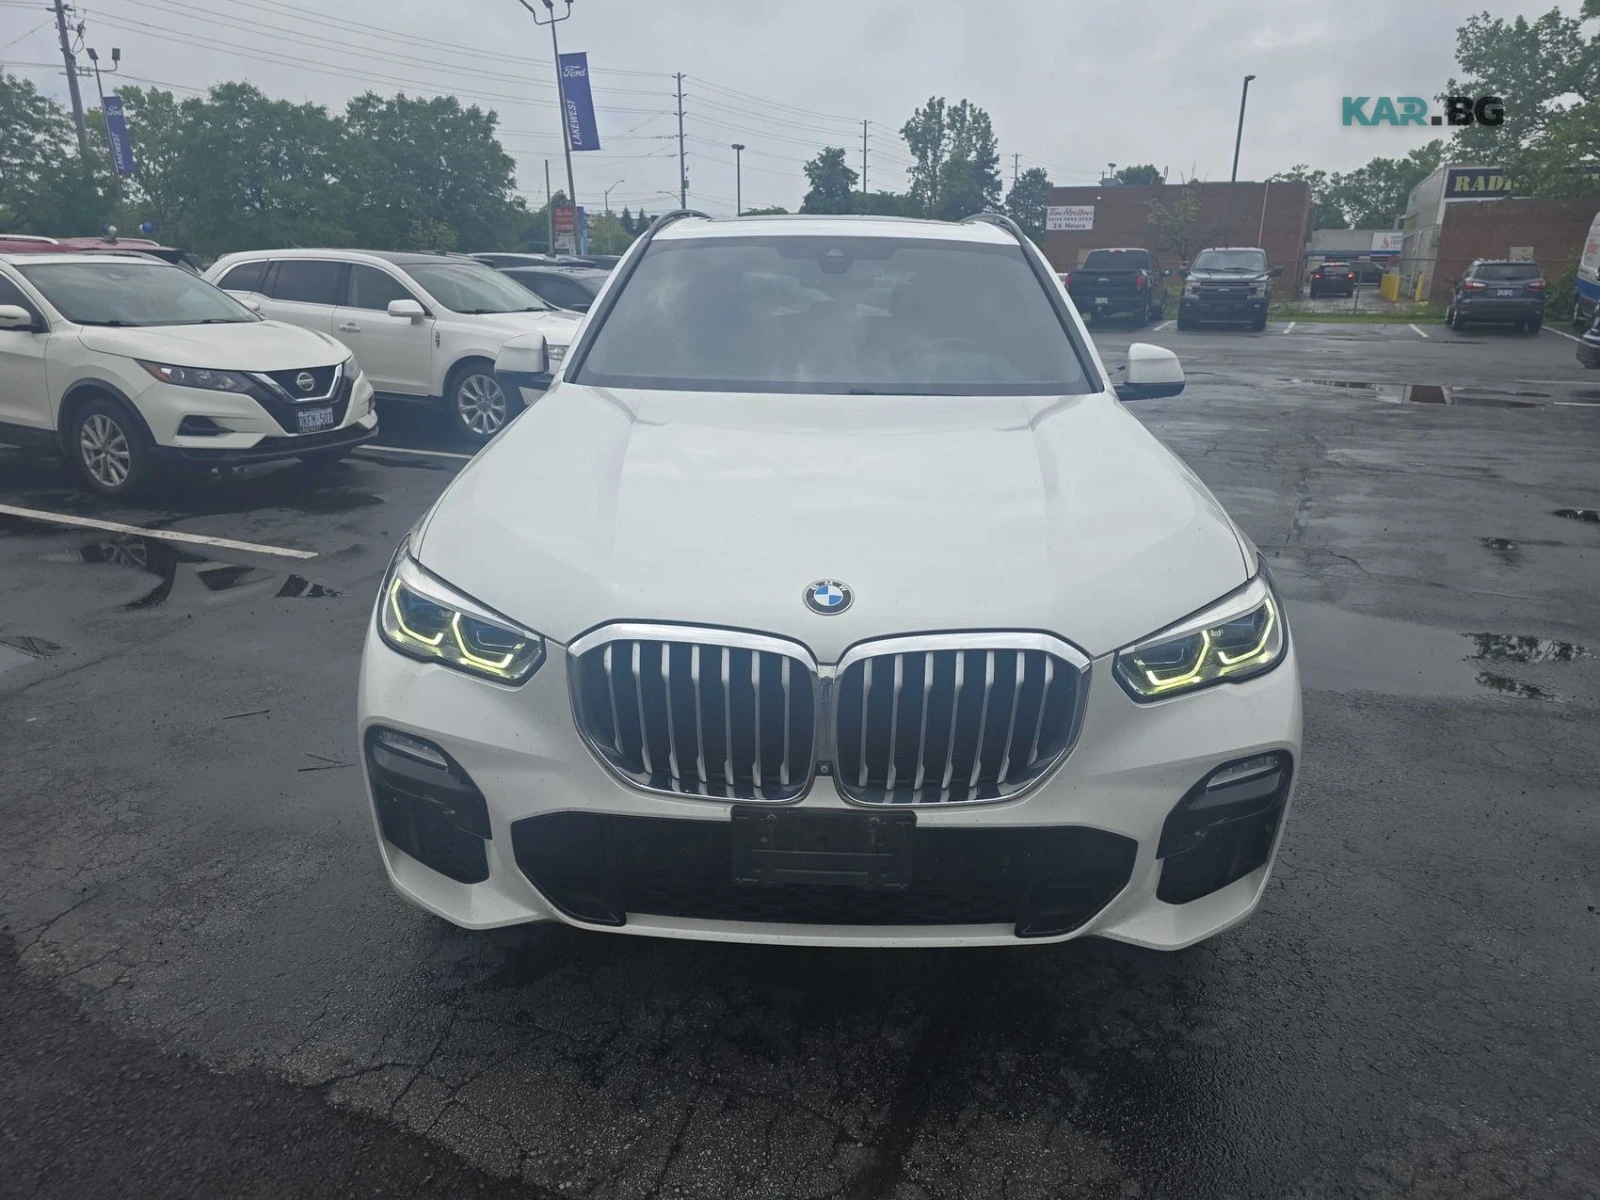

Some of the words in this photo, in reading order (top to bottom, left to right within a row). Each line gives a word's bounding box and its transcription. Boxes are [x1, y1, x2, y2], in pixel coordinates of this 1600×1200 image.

[563, 65, 586, 78] Ford
[566, 99, 583, 145] LAKEWEST
[1453, 175, 1512, 191] RADI
